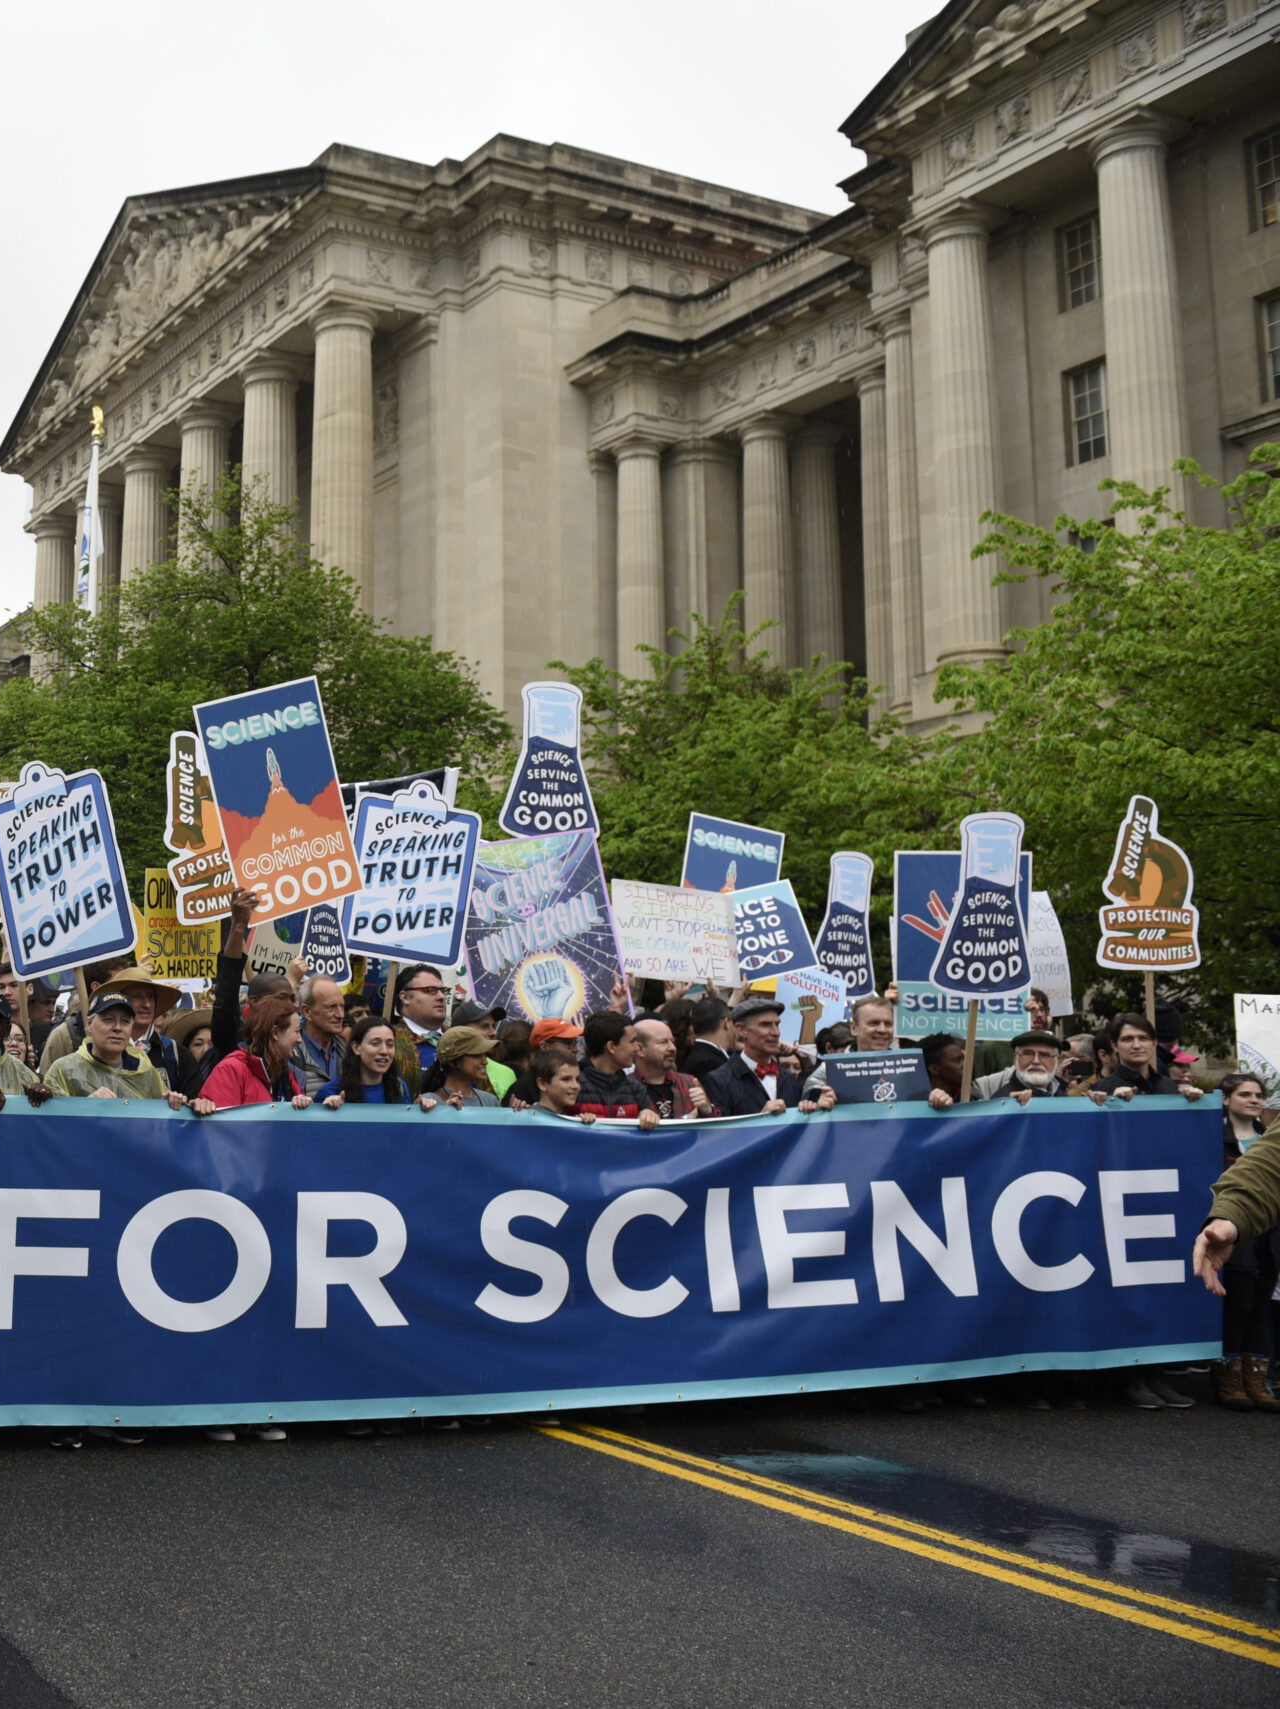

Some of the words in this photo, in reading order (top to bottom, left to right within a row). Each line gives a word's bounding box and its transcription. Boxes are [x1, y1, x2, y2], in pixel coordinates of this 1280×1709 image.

[206, 701, 318, 748] SCIENCE
[530, 750, 575, 768] SCIENCE
[527, 769, 578, 783] SERVING
[542, 781, 559, 791] THE
[179, 750, 195, 825] SCIENCE
[519, 791, 584, 807] COMMON
[6, 794, 68, 842] SCIENCE
[375, 811, 447, 835] SCIENCE
[513, 806, 588, 831] GOOD
[7, 794, 93, 870] SPEAKING
[271, 830, 287, 849] for
[288, 826, 305, 840] the
[365, 831, 466, 857] SPEAKING
[693, 829, 778, 861] SCIENCE
[1122, 811, 1149, 879] SCIENCE
[10, 821, 101, 899] TRUTH
[178, 850, 230, 880] PROTEC
[241, 831, 345, 880] COMMON
[363, 854, 462, 883] TRUTH
[213, 871, 234, 888] OU
[248, 859, 353, 913] GOOD
[50, 879, 67, 902] TO
[147, 878, 178, 909] OPIN
[397, 887, 416, 901] TO
[471, 857, 566, 924] SCIENCE
[624, 884, 714, 909] SILENCING
[967, 891, 1012, 911] SCIENCE
[22, 882, 112, 959] POWER
[352, 907, 454, 937] POWER
[666, 918, 701, 938] STOP
[756, 914, 780, 929] TO
[831, 913, 863, 932] SCIENCE
[962, 913, 1015, 928] SERVING
[1108, 910, 1191, 926] PROTECTING
[311, 925, 339, 937] SERVING
[320, 935, 329, 943] THE
[477, 892, 604, 974] UNIVERSAL
[827, 930, 864, 945] SERVING
[978, 928, 995, 938] THE
[1137, 928, 1166, 941] OUR
[148, 929, 217, 958] SCIENCE
[254, 944, 268, 958] I'M
[307, 942, 342, 956] COMMON
[622, 936, 643, 949] THE
[705, 943, 738, 959] RISIN
[838, 943, 850, 951] THE
[953, 937, 1019, 957] COMMON
[1107, 943, 1194, 961] COMMUNITIES
[153, 960, 164, 976] is
[168, 959, 216, 978] HARDER
[305, 955, 344, 975] GOOD
[624, 958, 642, 969] AND
[647, 957, 662, 972] SO
[665, 958, 688, 972] ARE
[692, 958, 725, 978] WE
[820, 950, 866, 967] COMMON
[945, 955, 1022, 984] GOOD
[783, 973, 840, 1002] SOLUTION
[824, 980, 839, 993] THE
[902, 1016, 939, 1029] NOT
[946, 1017, 1025, 1032] SILENCE
[896, 1066, 915, 1074] planet
[474, 1168, 1186, 1323] SCIENCE
